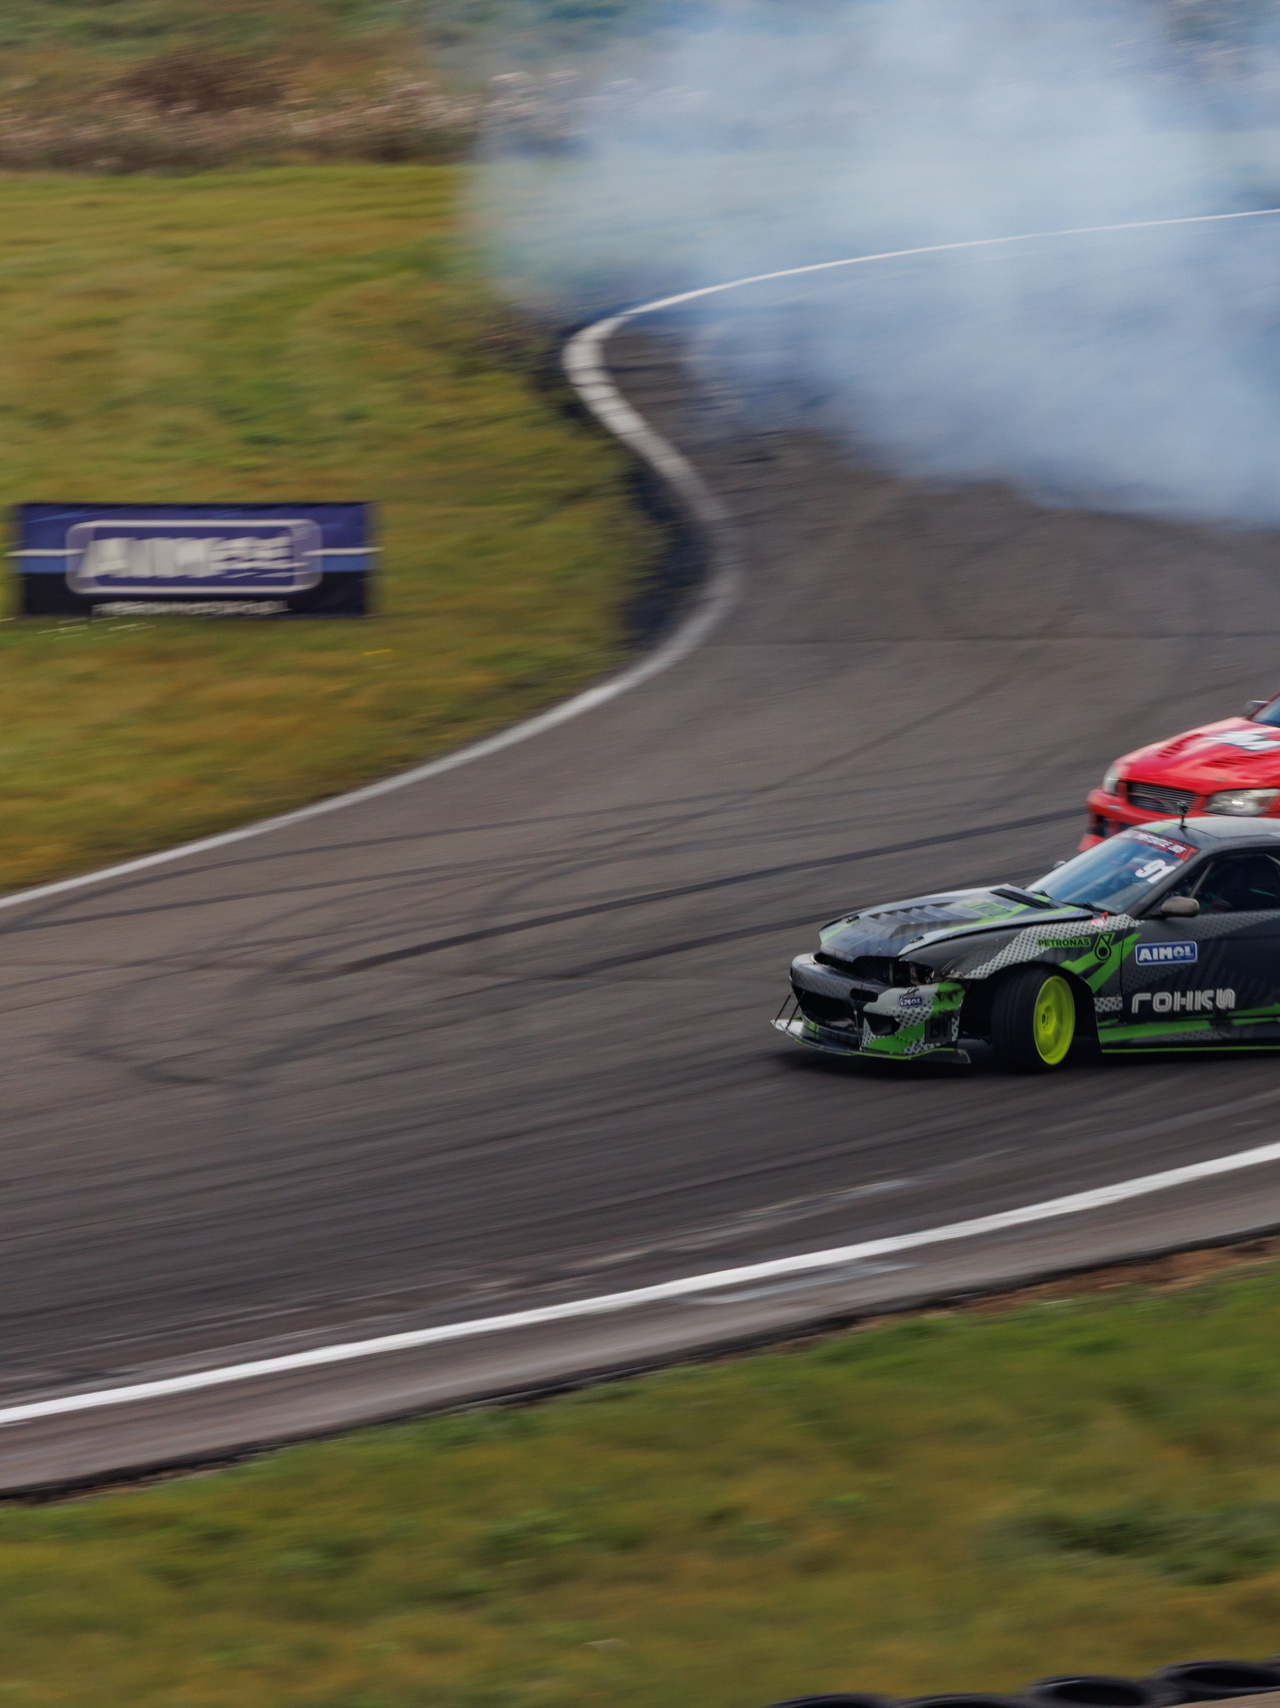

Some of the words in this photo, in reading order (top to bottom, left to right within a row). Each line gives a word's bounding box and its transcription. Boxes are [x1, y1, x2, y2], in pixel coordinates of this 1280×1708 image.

[77, 536, 310, 578] AIM
[1135, 859, 1176, 884] 91
[1037, 938, 1091, 947] PETRONAS
[1138, 945, 1194, 961] AIMOL
